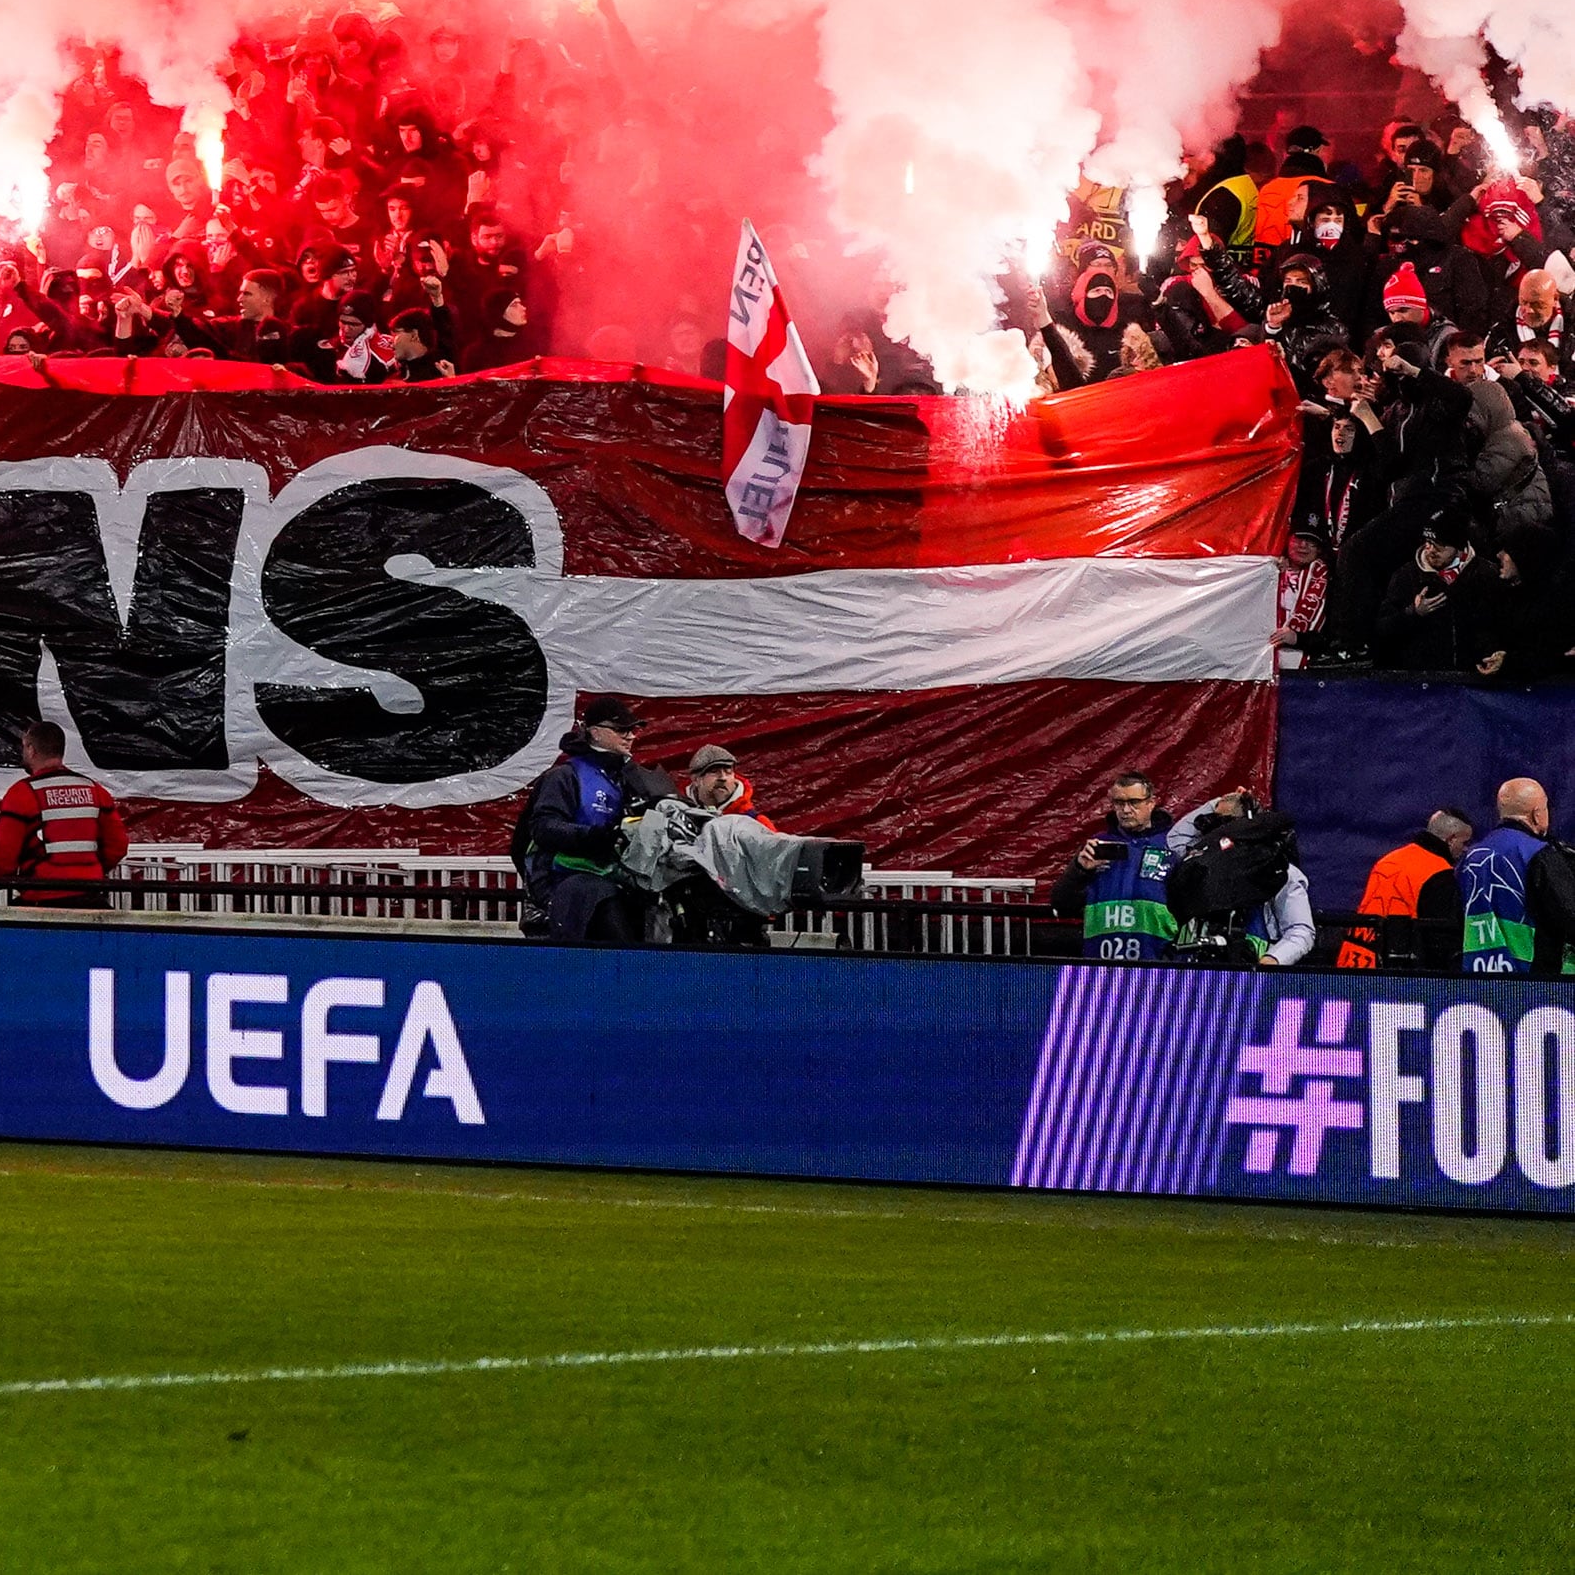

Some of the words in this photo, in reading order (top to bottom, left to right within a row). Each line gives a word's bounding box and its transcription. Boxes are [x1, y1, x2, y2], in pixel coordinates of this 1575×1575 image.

[1290, 560, 1328, 633] BRES
[47, 795, 95, 806] INCENDIE
[1104, 905, 1136, 928] HB
[1471, 917, 1496, 944] TV
[1100, 937, 1140, 961] 028
[88, 967, 486, 1125] UEFA
[1225, 997, 1575, 1190] #FOO
